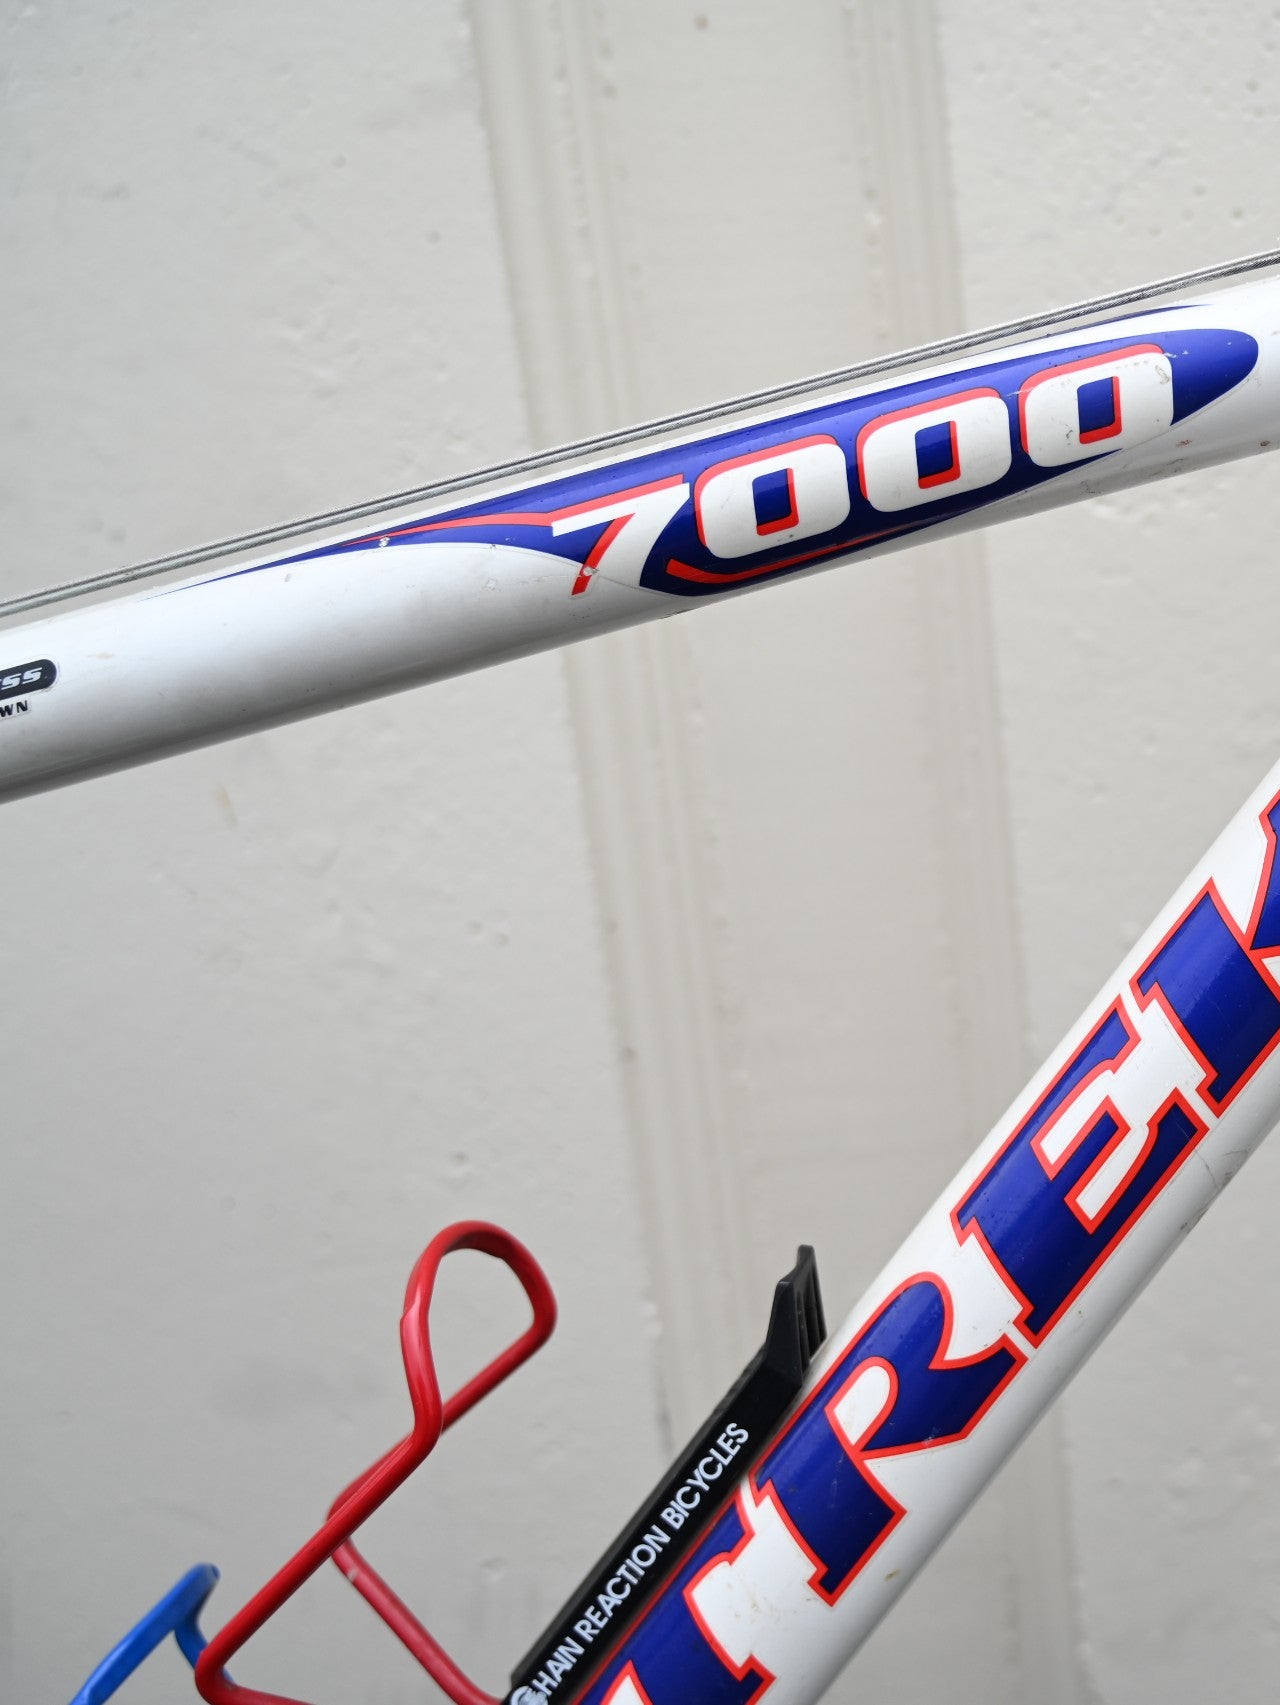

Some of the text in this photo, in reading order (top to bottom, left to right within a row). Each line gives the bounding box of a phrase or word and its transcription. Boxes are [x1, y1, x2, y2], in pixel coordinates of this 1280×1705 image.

[551, 343, 1174, 594] 7000
[0, 666, 43, 690] SS
[573, 1524, 671, 1643] REACTION
[660, 1422, 750, 1530] BICYCLES
